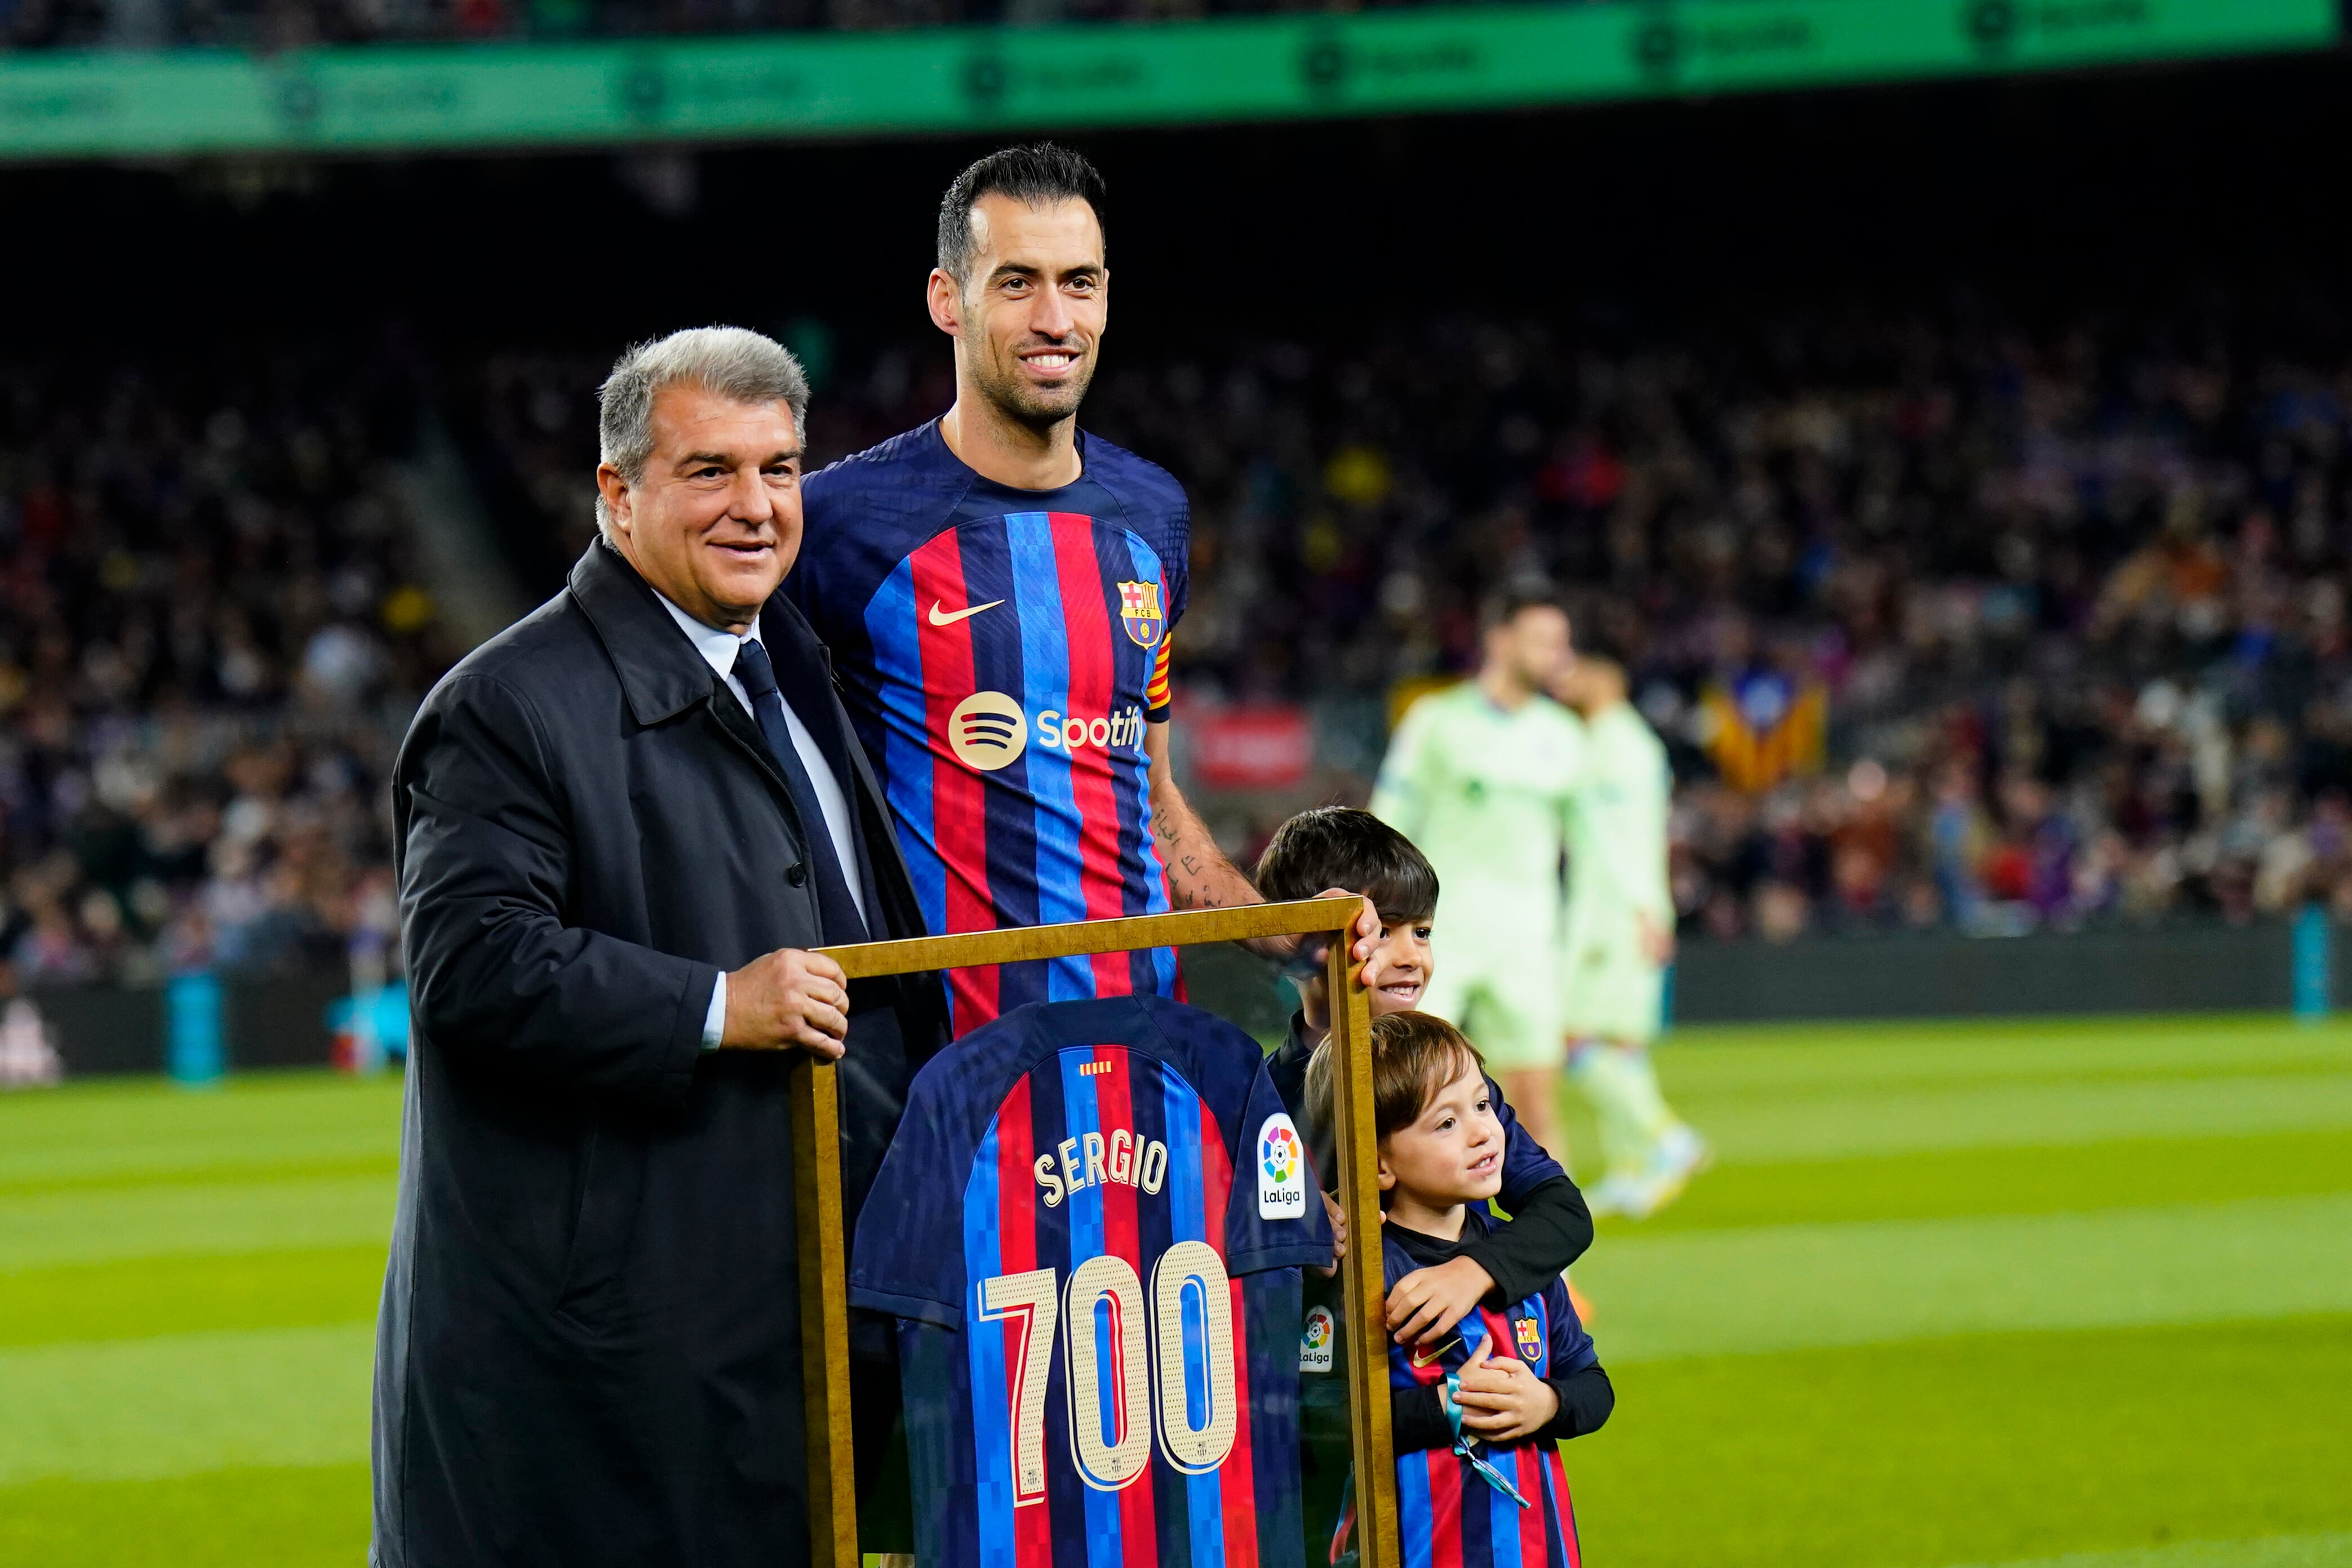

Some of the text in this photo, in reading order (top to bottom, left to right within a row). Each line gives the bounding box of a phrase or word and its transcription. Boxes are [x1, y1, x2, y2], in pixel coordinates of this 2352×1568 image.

[1037, 705, 1143, 754] Spotify
[1033, 1129, 1168, 1208] SERGIO
[1264, 1187, 1300, 1206] LaLiga
[977, 1241, 1238, 1508] 700
